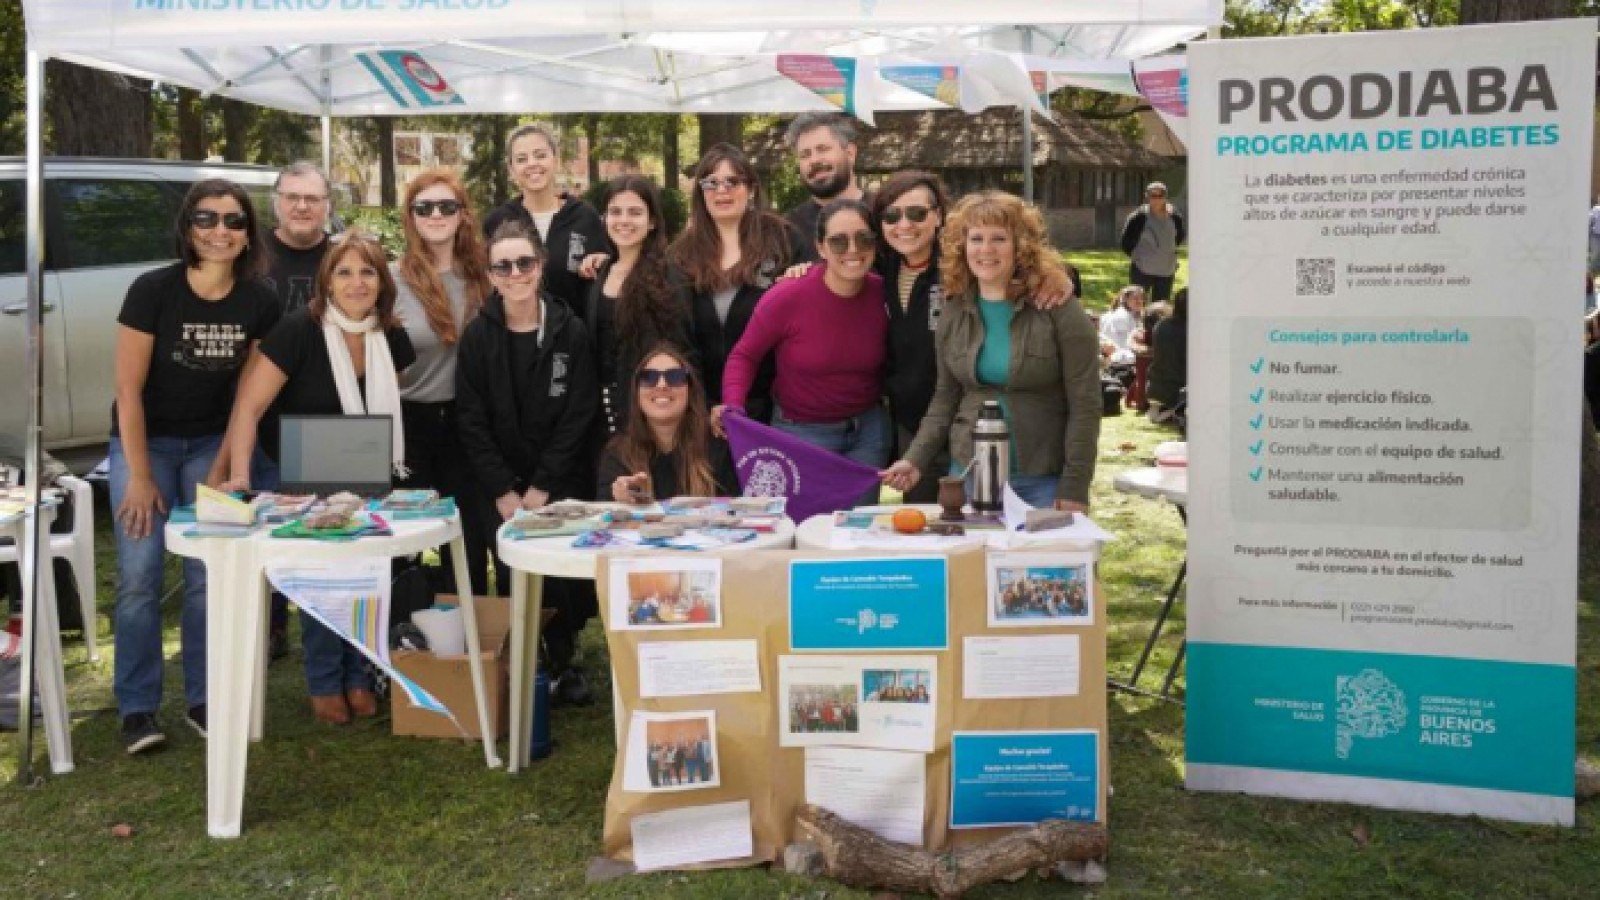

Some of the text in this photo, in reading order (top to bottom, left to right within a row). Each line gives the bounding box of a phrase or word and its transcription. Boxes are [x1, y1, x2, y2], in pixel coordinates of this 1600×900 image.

[1218, 64, 1559, 125] PRODIABA
[1217, 123, 1560, 157] PROGRAMA DE DIABETES
[1245, 165, 1526, 188] La diabetes es una enfermedad crónica
[1244, 183, 1526, 206] que se caracteriza por presentar niveles
[1243, 201, 1527, 221] altos de azúcar en sangre y puede darse
[1320, 221, 1441, 238] a cualquier edad.
[1269, 328, 1470, 346] Consejos para controlarla
[1269, 361, 1342, 375] No fumar.
[1269, 389, 1434, 405] Realizar ejercicio físico.
[1268, 416, 1473, 432] Usar la medicación indicada.
[1268, 442, 1505, 461] Consultar con el equipo de salud.
[1268, 468, 1465, 486] Mantener una alimentación
[1268, 487, 1342, 502] saludable.
[1288, 547, 1311, 558] por
[1311, 546, 1324, 558] el
[1325, 546, 1391, 560] PRODIABA
[1393, 551, 1409, 562] en
[1411, 550, 1423, 563] el
[1424, 551, 1469, 565] efector
[1471, 553, 1487, 566] de
[1489, 554, 1524, 568] salud
[1295, 561, 1456, 578] más cercano a tu domicilio.
[1419, 713, 1497, 734] BUENOS
[1418, 730, 1474, 748] AIRES
